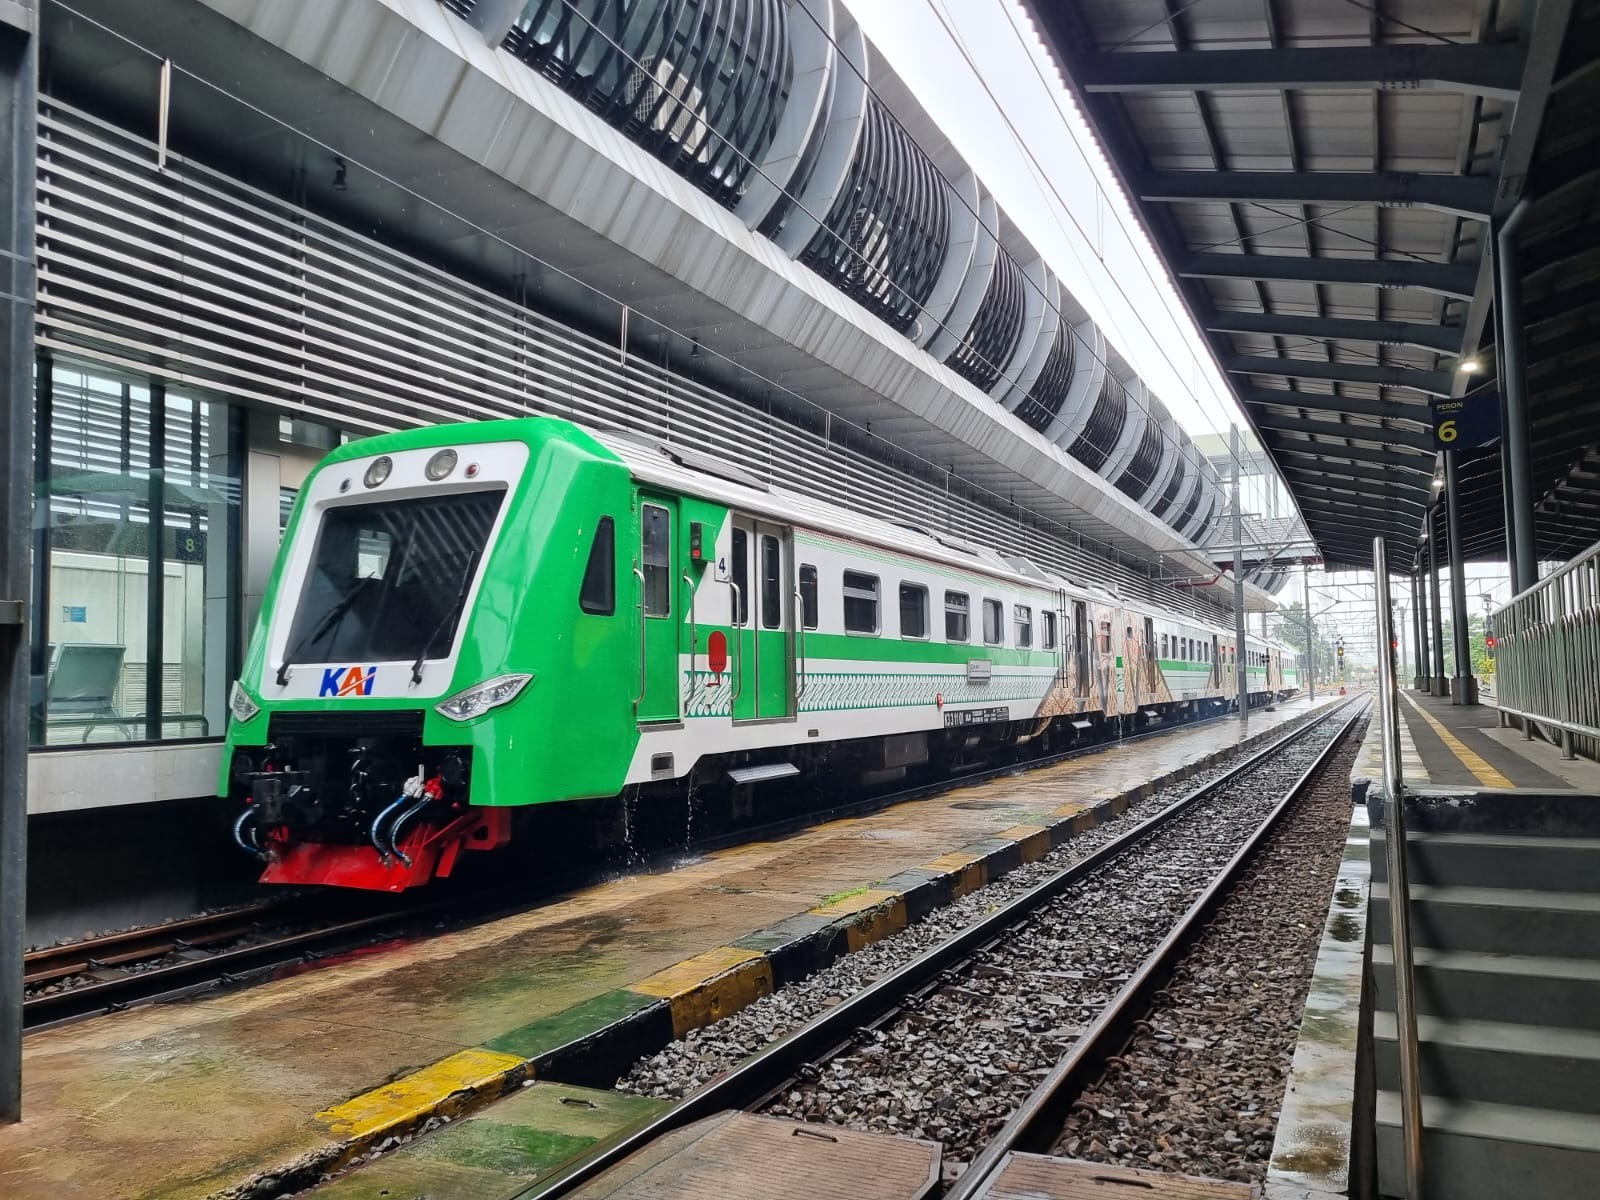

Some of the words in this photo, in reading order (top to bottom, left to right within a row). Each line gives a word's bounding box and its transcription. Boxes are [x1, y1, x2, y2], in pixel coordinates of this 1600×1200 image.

[1436, 401, 1463, 410] PERON
[1438, 420, 1457, 442] 6
[185, 538, 195, 552] 8
[718, 557, 726, 573] 4
[319, 666, 377, 697] KAI
